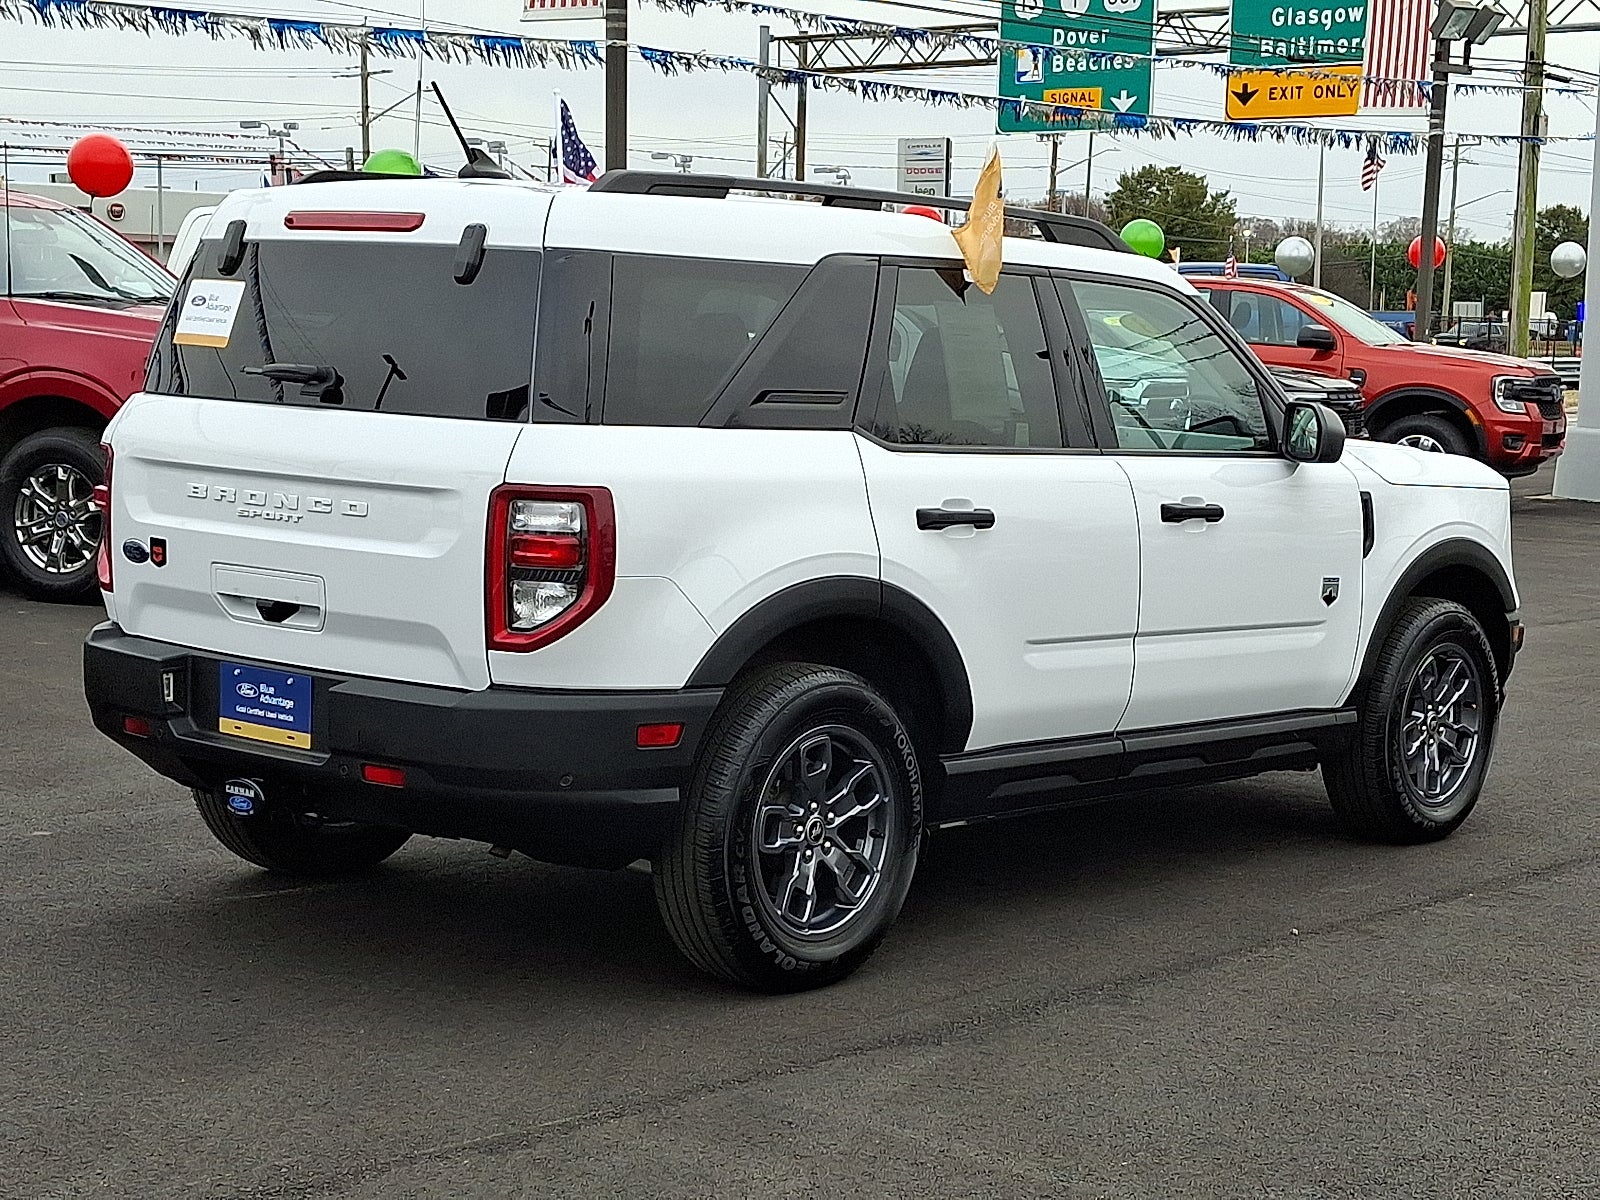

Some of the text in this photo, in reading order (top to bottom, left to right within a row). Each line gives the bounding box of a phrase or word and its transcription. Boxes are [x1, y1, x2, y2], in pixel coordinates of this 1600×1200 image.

[1271, 6, 1365, 31] Glasgow
[1053, 28, 1110, 46] Dover
[1050, 91, 1095, 104] SIGNAL
[1268, 83, 1358, 101] EXIT ONLY
[186, 482, 369, 517] BRONCO
[236, 508, 304, 523] SPORT
[259, 683, 275, 695] Blue
[259, 694, 295, 710] Advantage
[893, 723, 921, 828] YOKOHAMA
